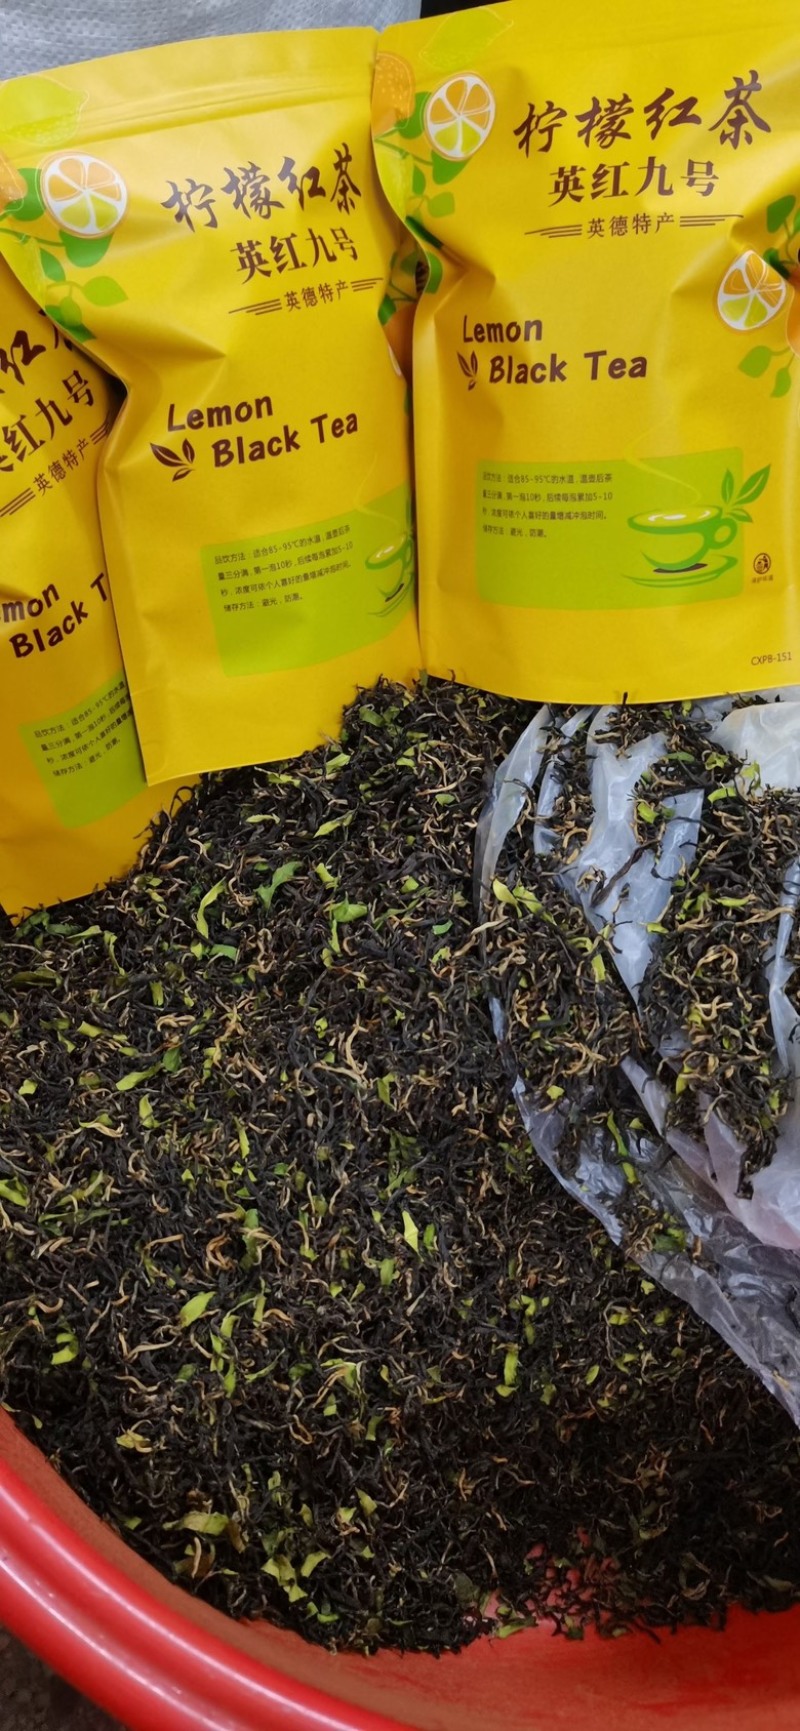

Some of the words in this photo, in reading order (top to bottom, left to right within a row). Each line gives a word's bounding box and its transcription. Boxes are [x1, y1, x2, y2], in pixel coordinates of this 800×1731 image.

[513, 69, 772, 158] 柠檬红茶
[160, 142, 362, 232] 柠檬红茶
[548, 156, 719, 208] 英红九号
[586, 212, 675, 239] 英德特产
[230, 227, 358, 285] 英红九号
[283, 280, 349, 312] 英德特产
[462, 314, 543, 343] Lemon
[489, 353, 567, 384] Black
[584, 350, 648, 381] Tea
[167, 395, 273, 432] Lemon
[211, 424, 301, 468] Black
[310, 413, 358, 443] Tea
[33, 438, 90, 496] 英德特产
[0, 584, 60, 623] mon
[9, 600, 89, 658] Black
[750, 651, 792, 666] CXPB-151
